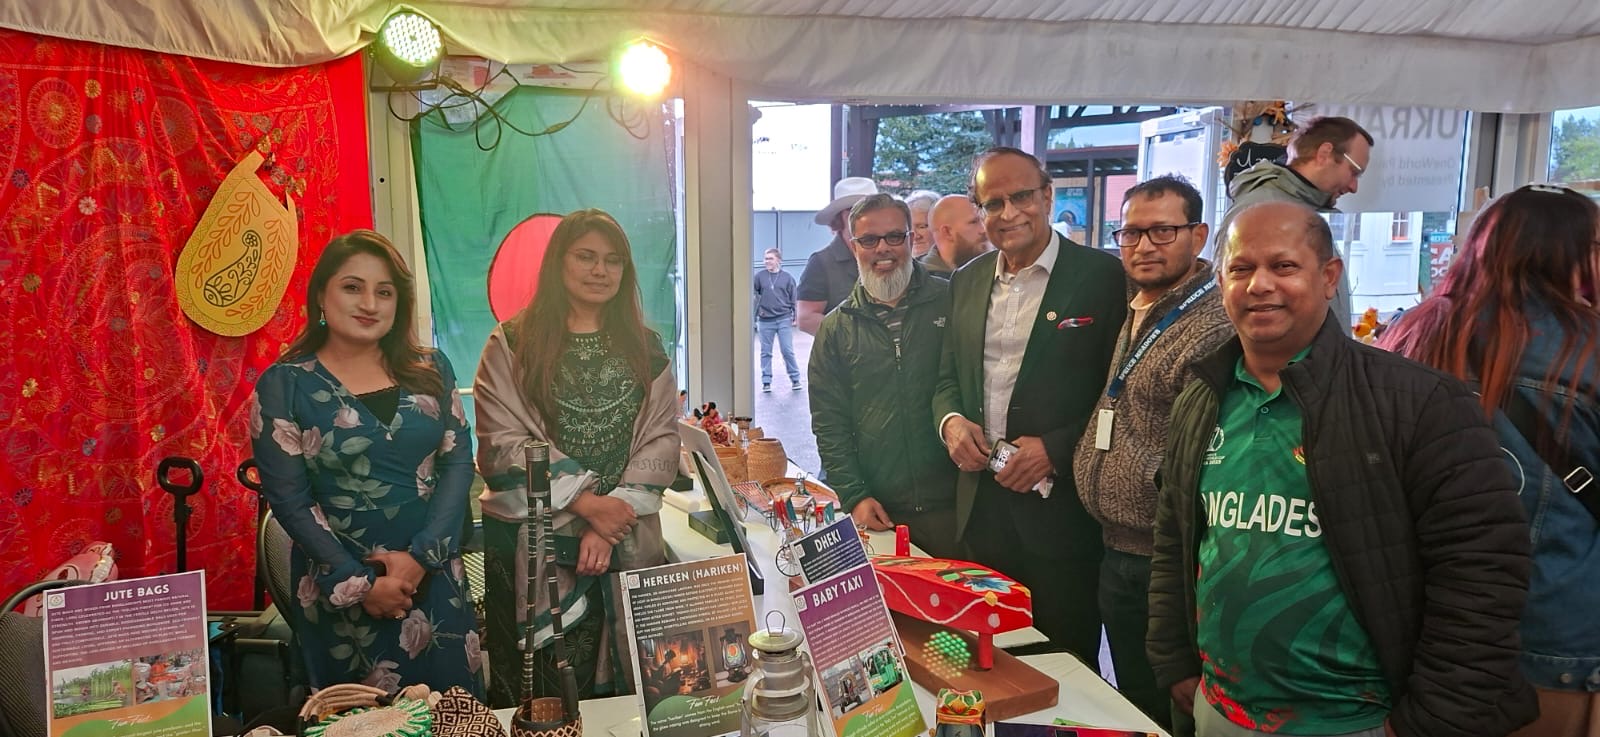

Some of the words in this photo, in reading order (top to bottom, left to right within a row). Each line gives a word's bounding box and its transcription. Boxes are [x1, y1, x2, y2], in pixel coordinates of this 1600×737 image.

[1134, 328, 1161, 360] MEADOWS
[1201, 491, 1322, 538] NGLADES
[814, 528, 842, 553] DHEKI
[643, 571, 690, 588] HEREKEN
[692, 562, 744, 582] (HARIKEN)
[103, 588, 133, 602] JUTE
[137, 584, 170, 597] BAGS
[812, 584, 839, 608] BABY
[840, 574, 864, 595] TAXI
